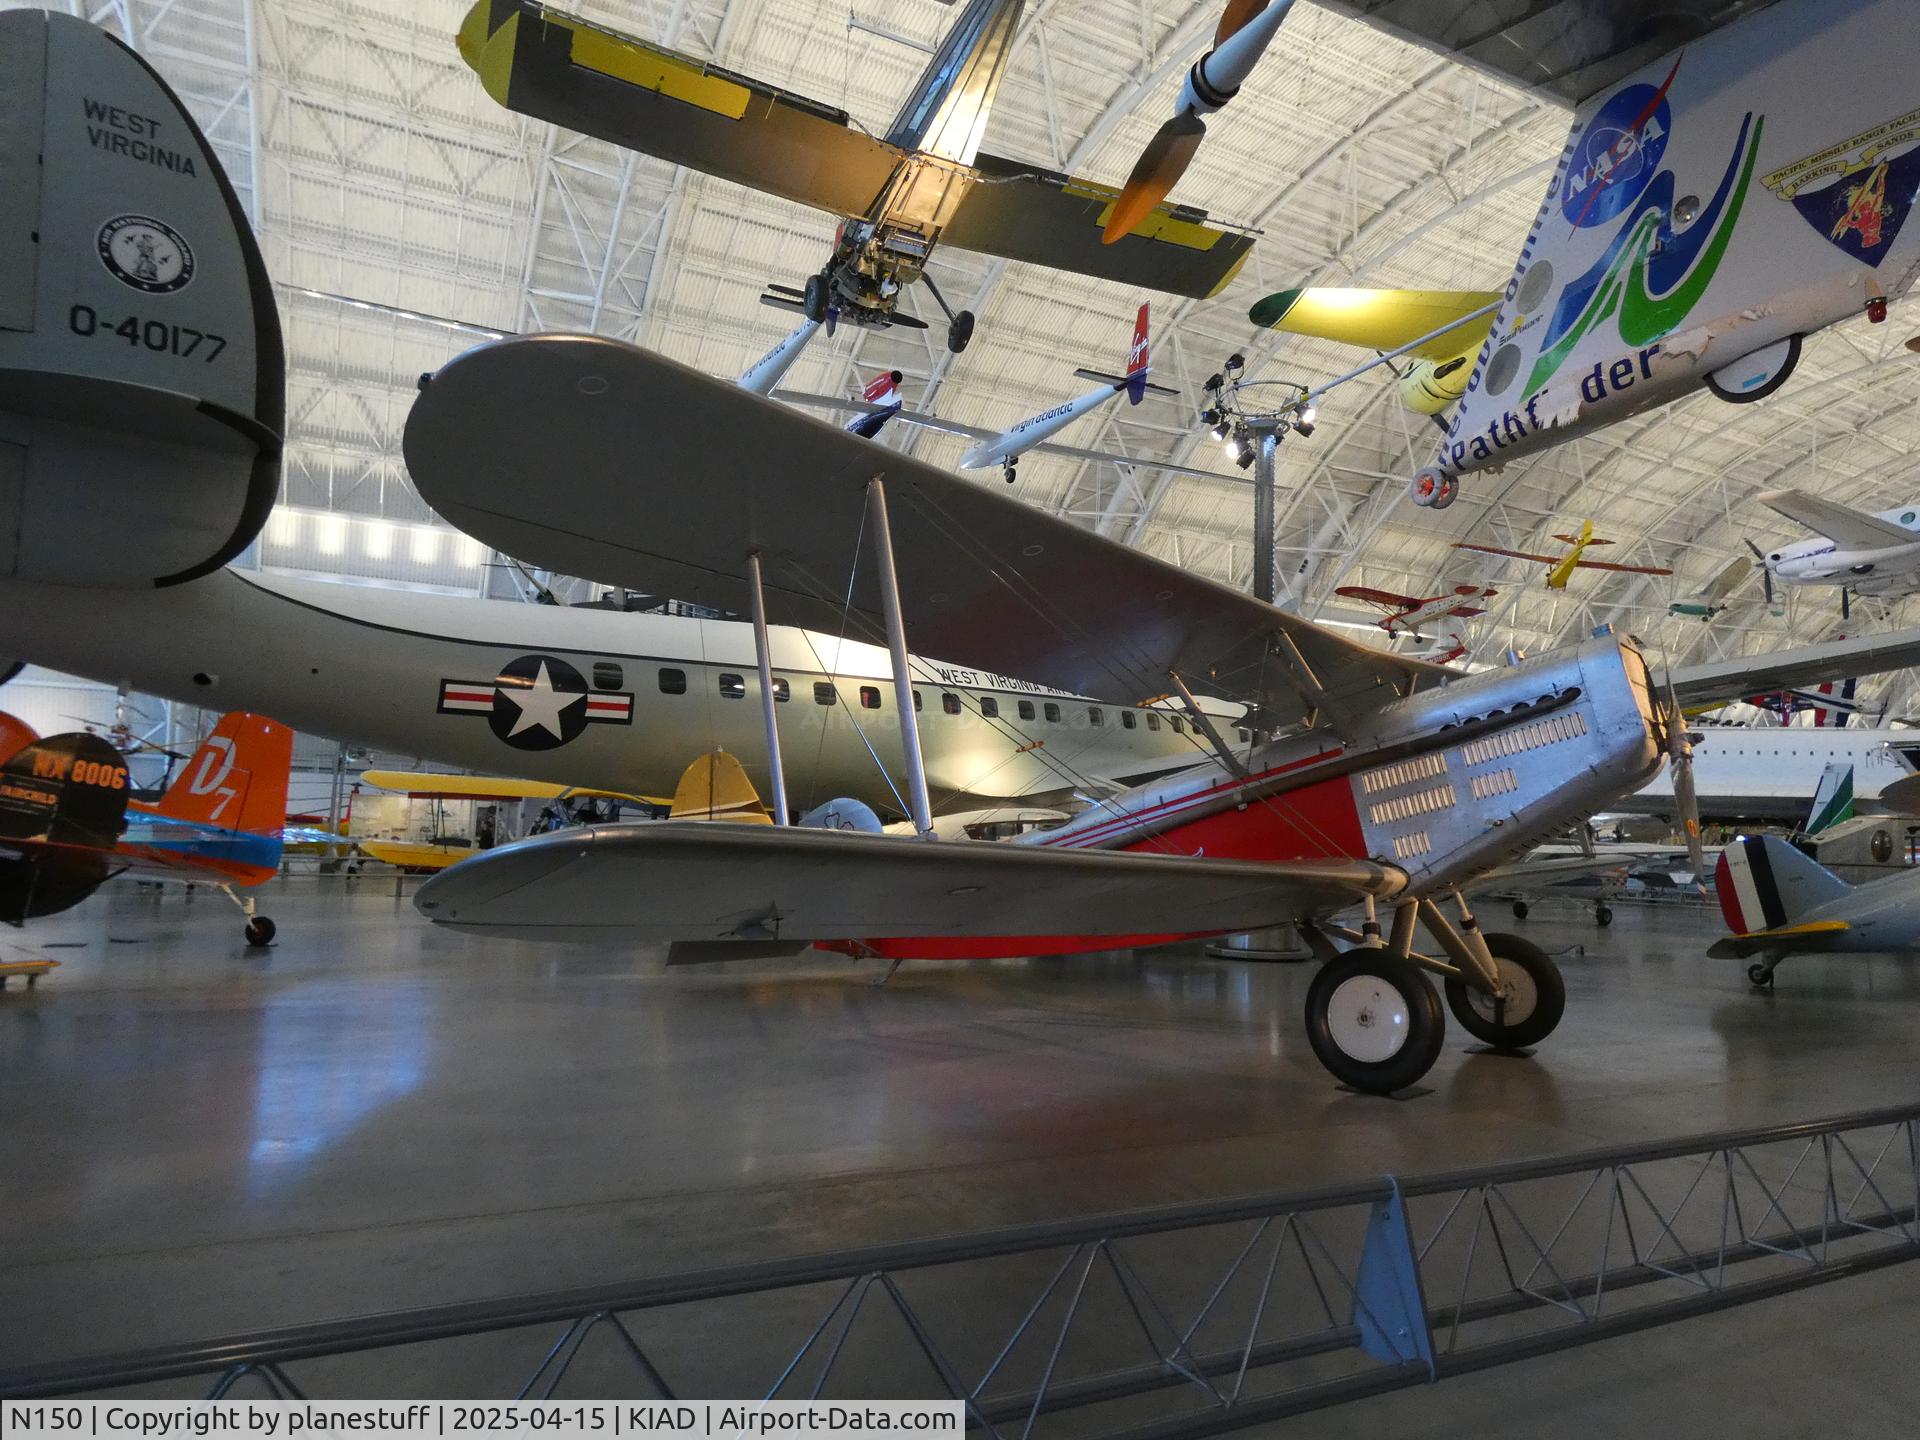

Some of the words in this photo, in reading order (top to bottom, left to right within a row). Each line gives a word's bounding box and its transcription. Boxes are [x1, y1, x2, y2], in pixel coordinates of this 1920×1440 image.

[83, 97, 161, 139] WEST
[88, 125, 197, 178] VIRGINIA
[1568, 115, 1667, 200] NASA
[1772, 162, 1807, 181] PACIFIC
[1811, 143, 1849, 164] MISSILE
[1852, 128, 1887, 146] RANGE
[1890, 111, 1920, 130] FACIL
[1791, 164, 1838, 190] BARKING
[1876, 131, 1915, 150] SANDS
[1035, 402, 1073, 424] atlantic
[1451, 342, 1660, 471] Pathfder
[937, 667, 978, 686] WEST
[985, 673, 1041, 692] VIRGINIA
[33, 751, 67, 780] NX
[72, 759, 128, 790] 8006
